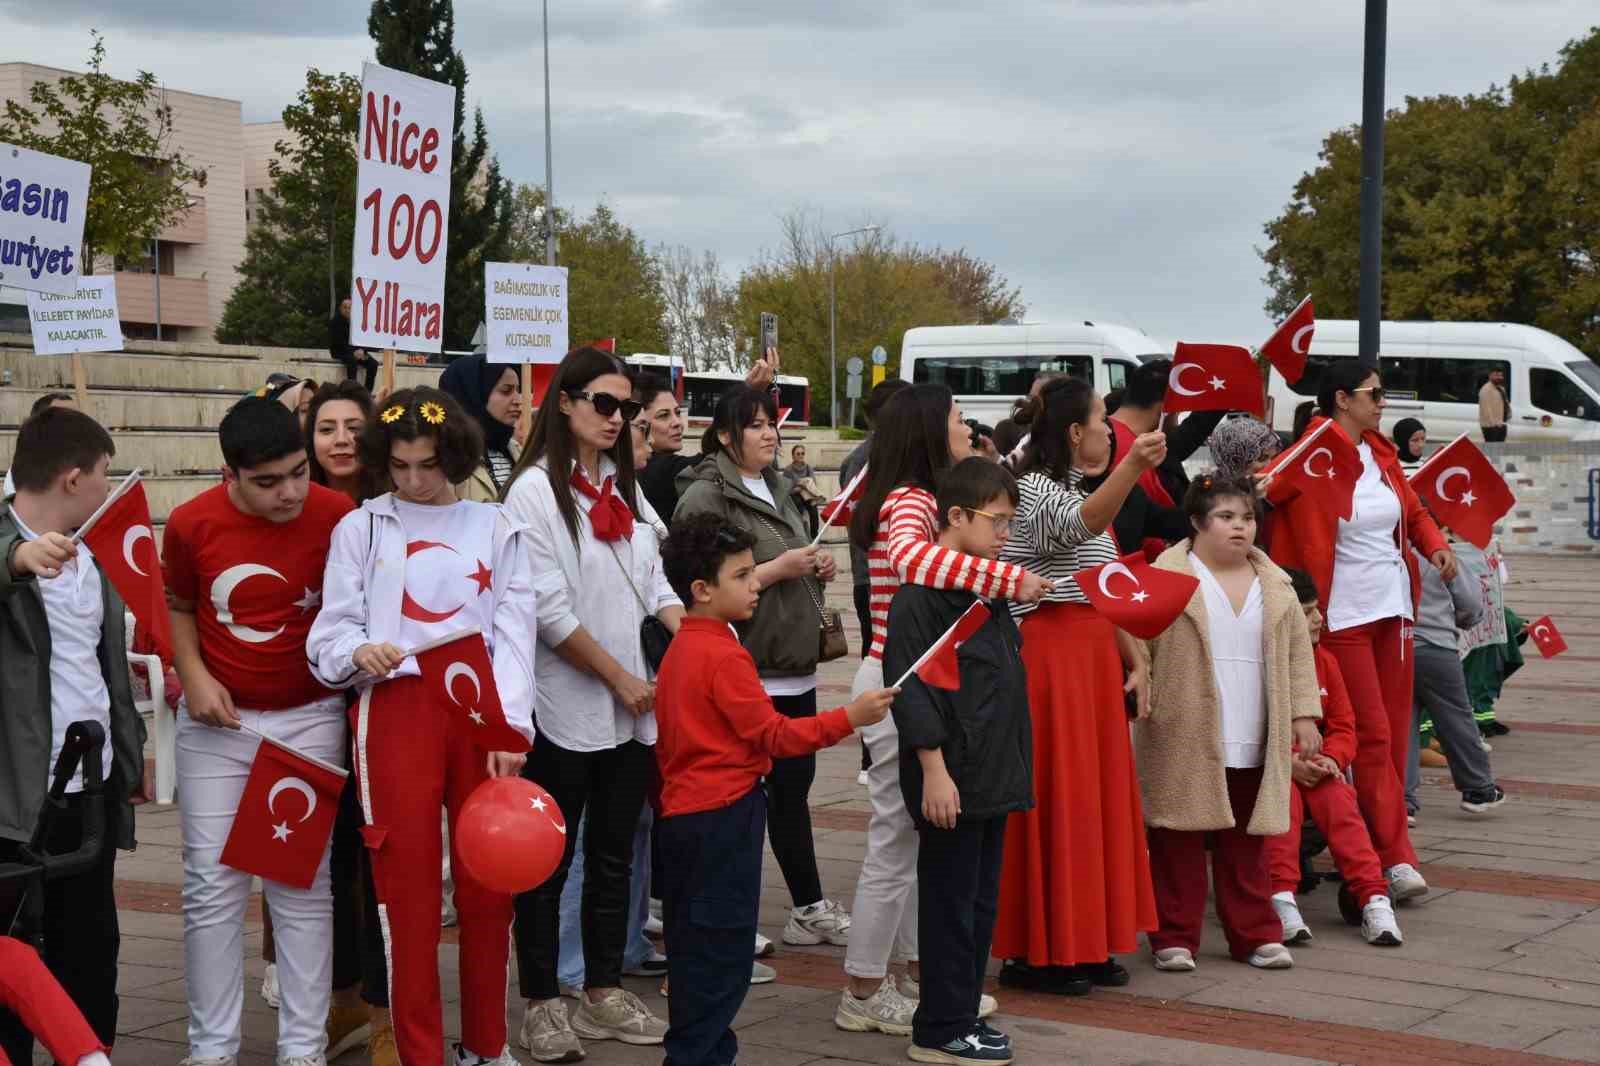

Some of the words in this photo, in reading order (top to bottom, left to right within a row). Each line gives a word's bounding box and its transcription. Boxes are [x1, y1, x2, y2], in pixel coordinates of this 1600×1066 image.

[363, 90, 440, 174] Nice
[0, 175, 69, 223] asın
[363, 187, 443, 265] 100
[0, 235, 74, 279] uriyet
[355, 276, 441, 340] Yıllara
[494, 278, 548, 297] BAĞIMSIZLIK
[549, 285, 561, 298] VE
[33, 308, 75, 322] İLELEBET
[76, 306, 114, 320] PAYİDAR
[492, 306, 543, 322] EGEMENLİK
[544, 308, 562, 325] ÇOK
[504, 333, 552, 348] KUTSALDIR
